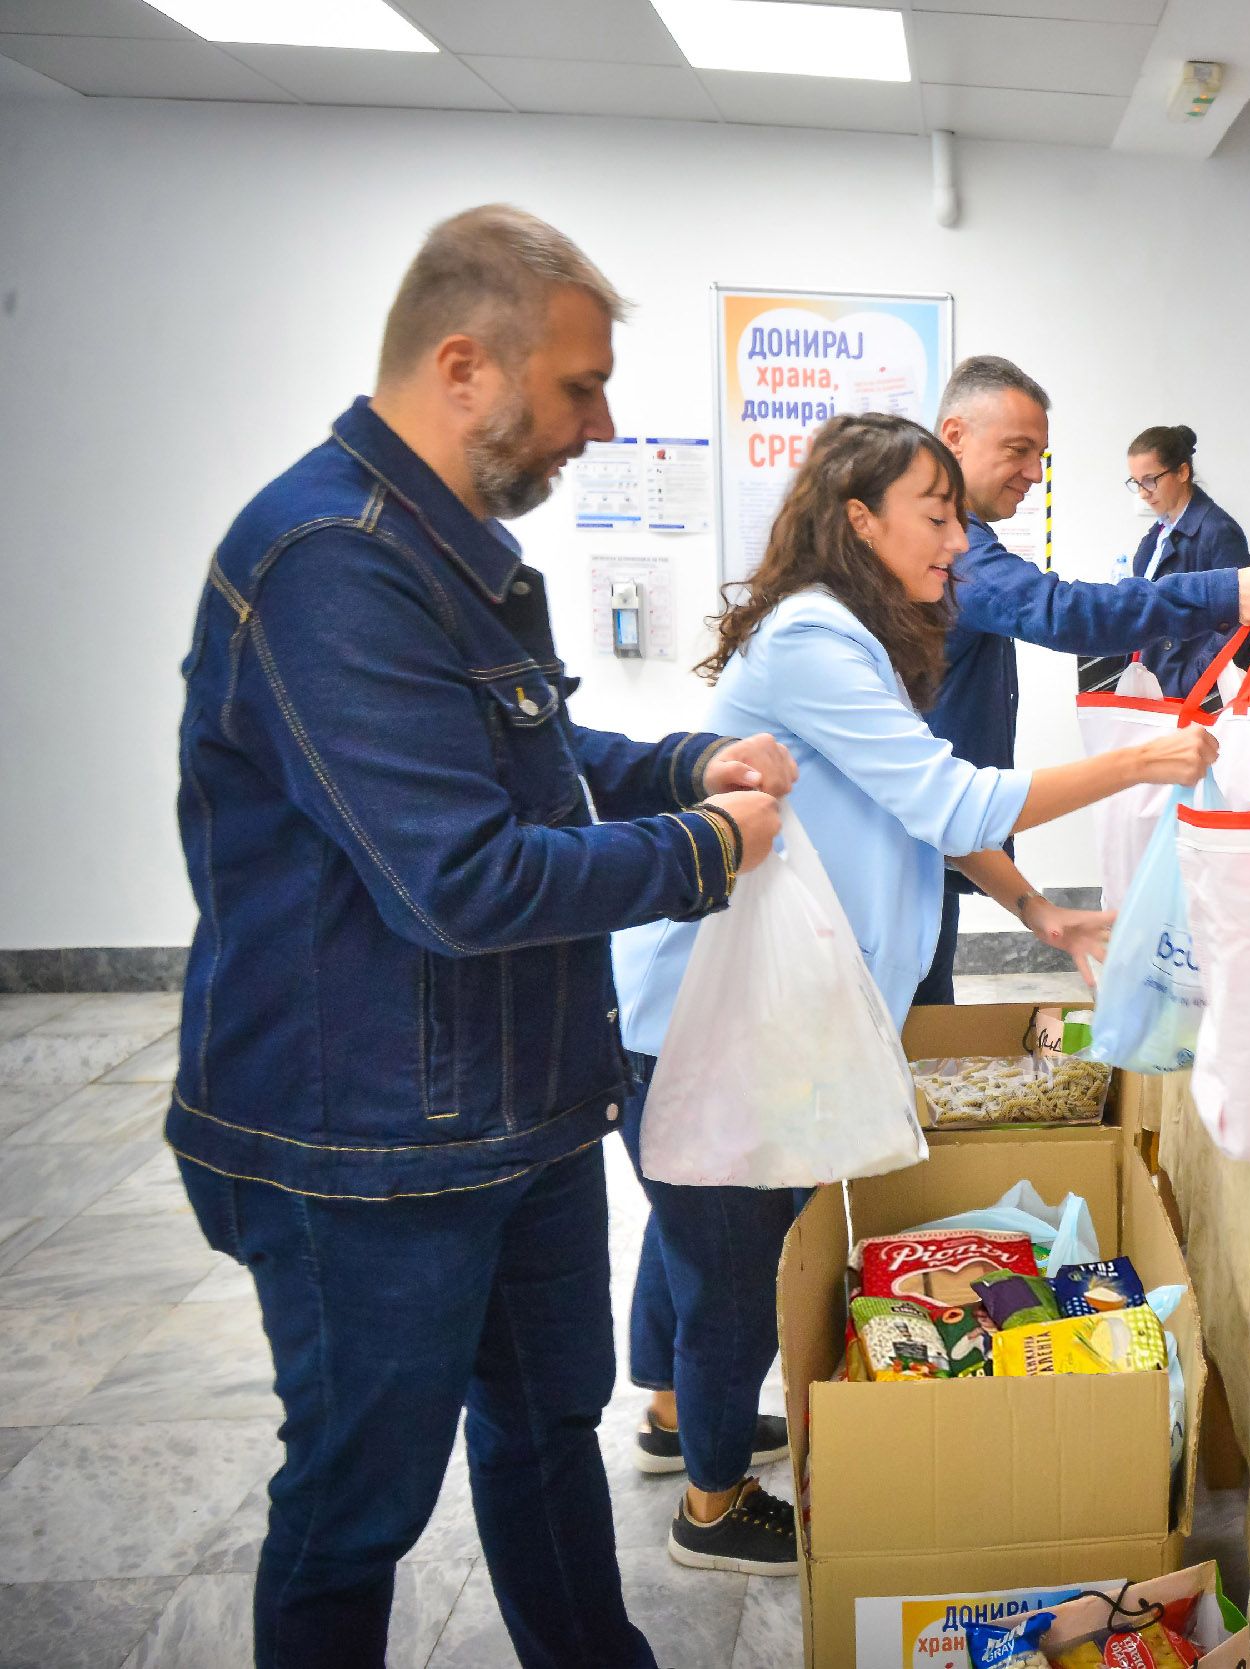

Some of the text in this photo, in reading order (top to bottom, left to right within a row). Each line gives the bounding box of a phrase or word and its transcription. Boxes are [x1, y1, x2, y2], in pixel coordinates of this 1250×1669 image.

[748, 327, 864, 360] ДОНИРАЈ
[756, 366, 839, 394] храна,
[748, 433, 813, 468] СРЕ
[918, 1636, 965, 1657] хран
